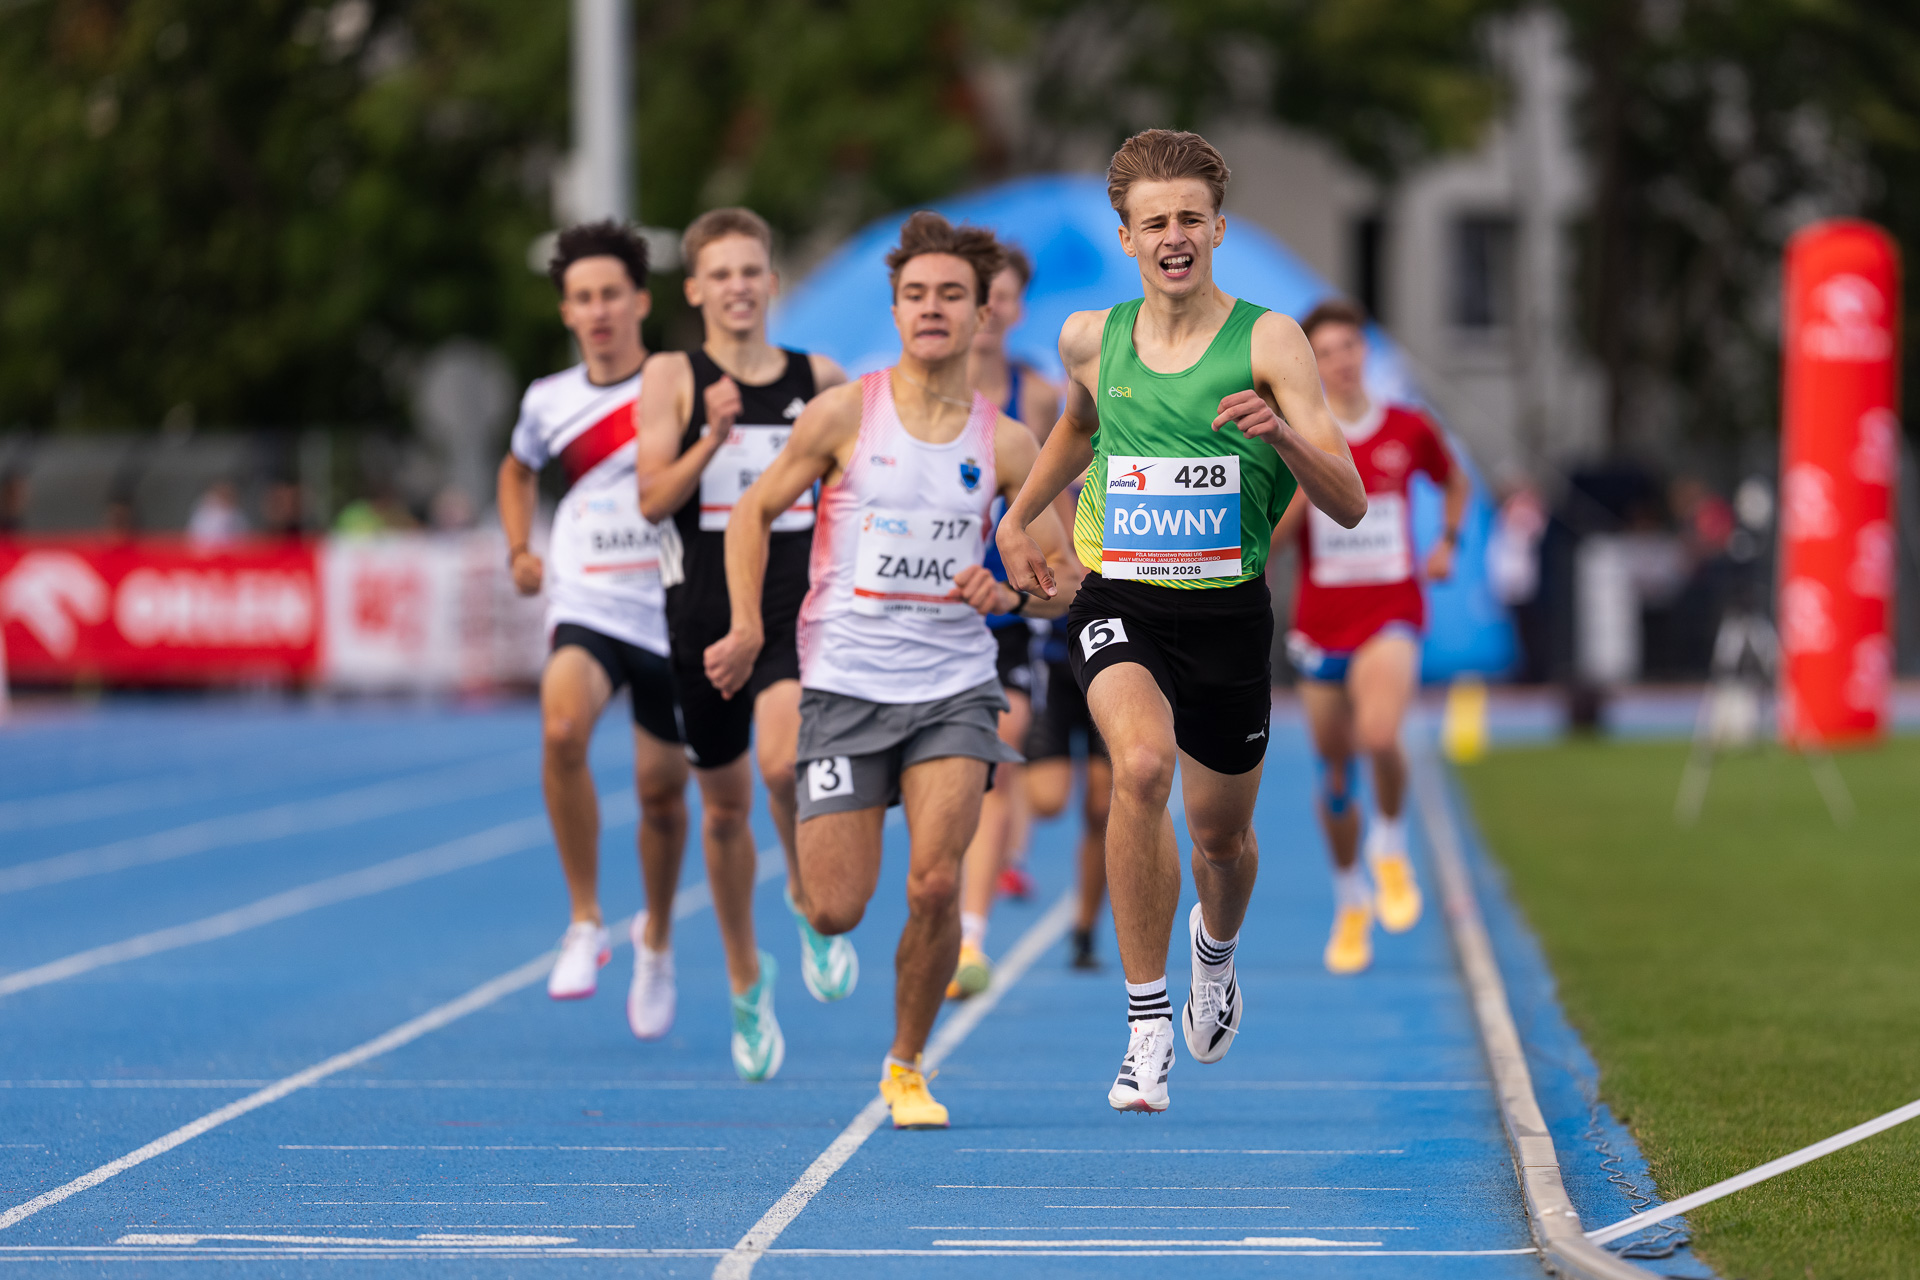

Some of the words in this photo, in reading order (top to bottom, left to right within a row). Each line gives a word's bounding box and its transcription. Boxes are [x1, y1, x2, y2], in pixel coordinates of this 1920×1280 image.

[1109, 478, 1137, 489] polanik
[1174, 464, 1227, 489] 428
[931, 519, 972, 541] 717
[1113, 502, 1228, 536] RÓWNY
[875, 553, 958, 586] ZAJĄC
[1136, 566, 1170, 575] LUBIN
[1172, 565, 1202, 575] 2026
[1088, 618, 1115, 650] 5
[817, 757, 840, 791] 3
